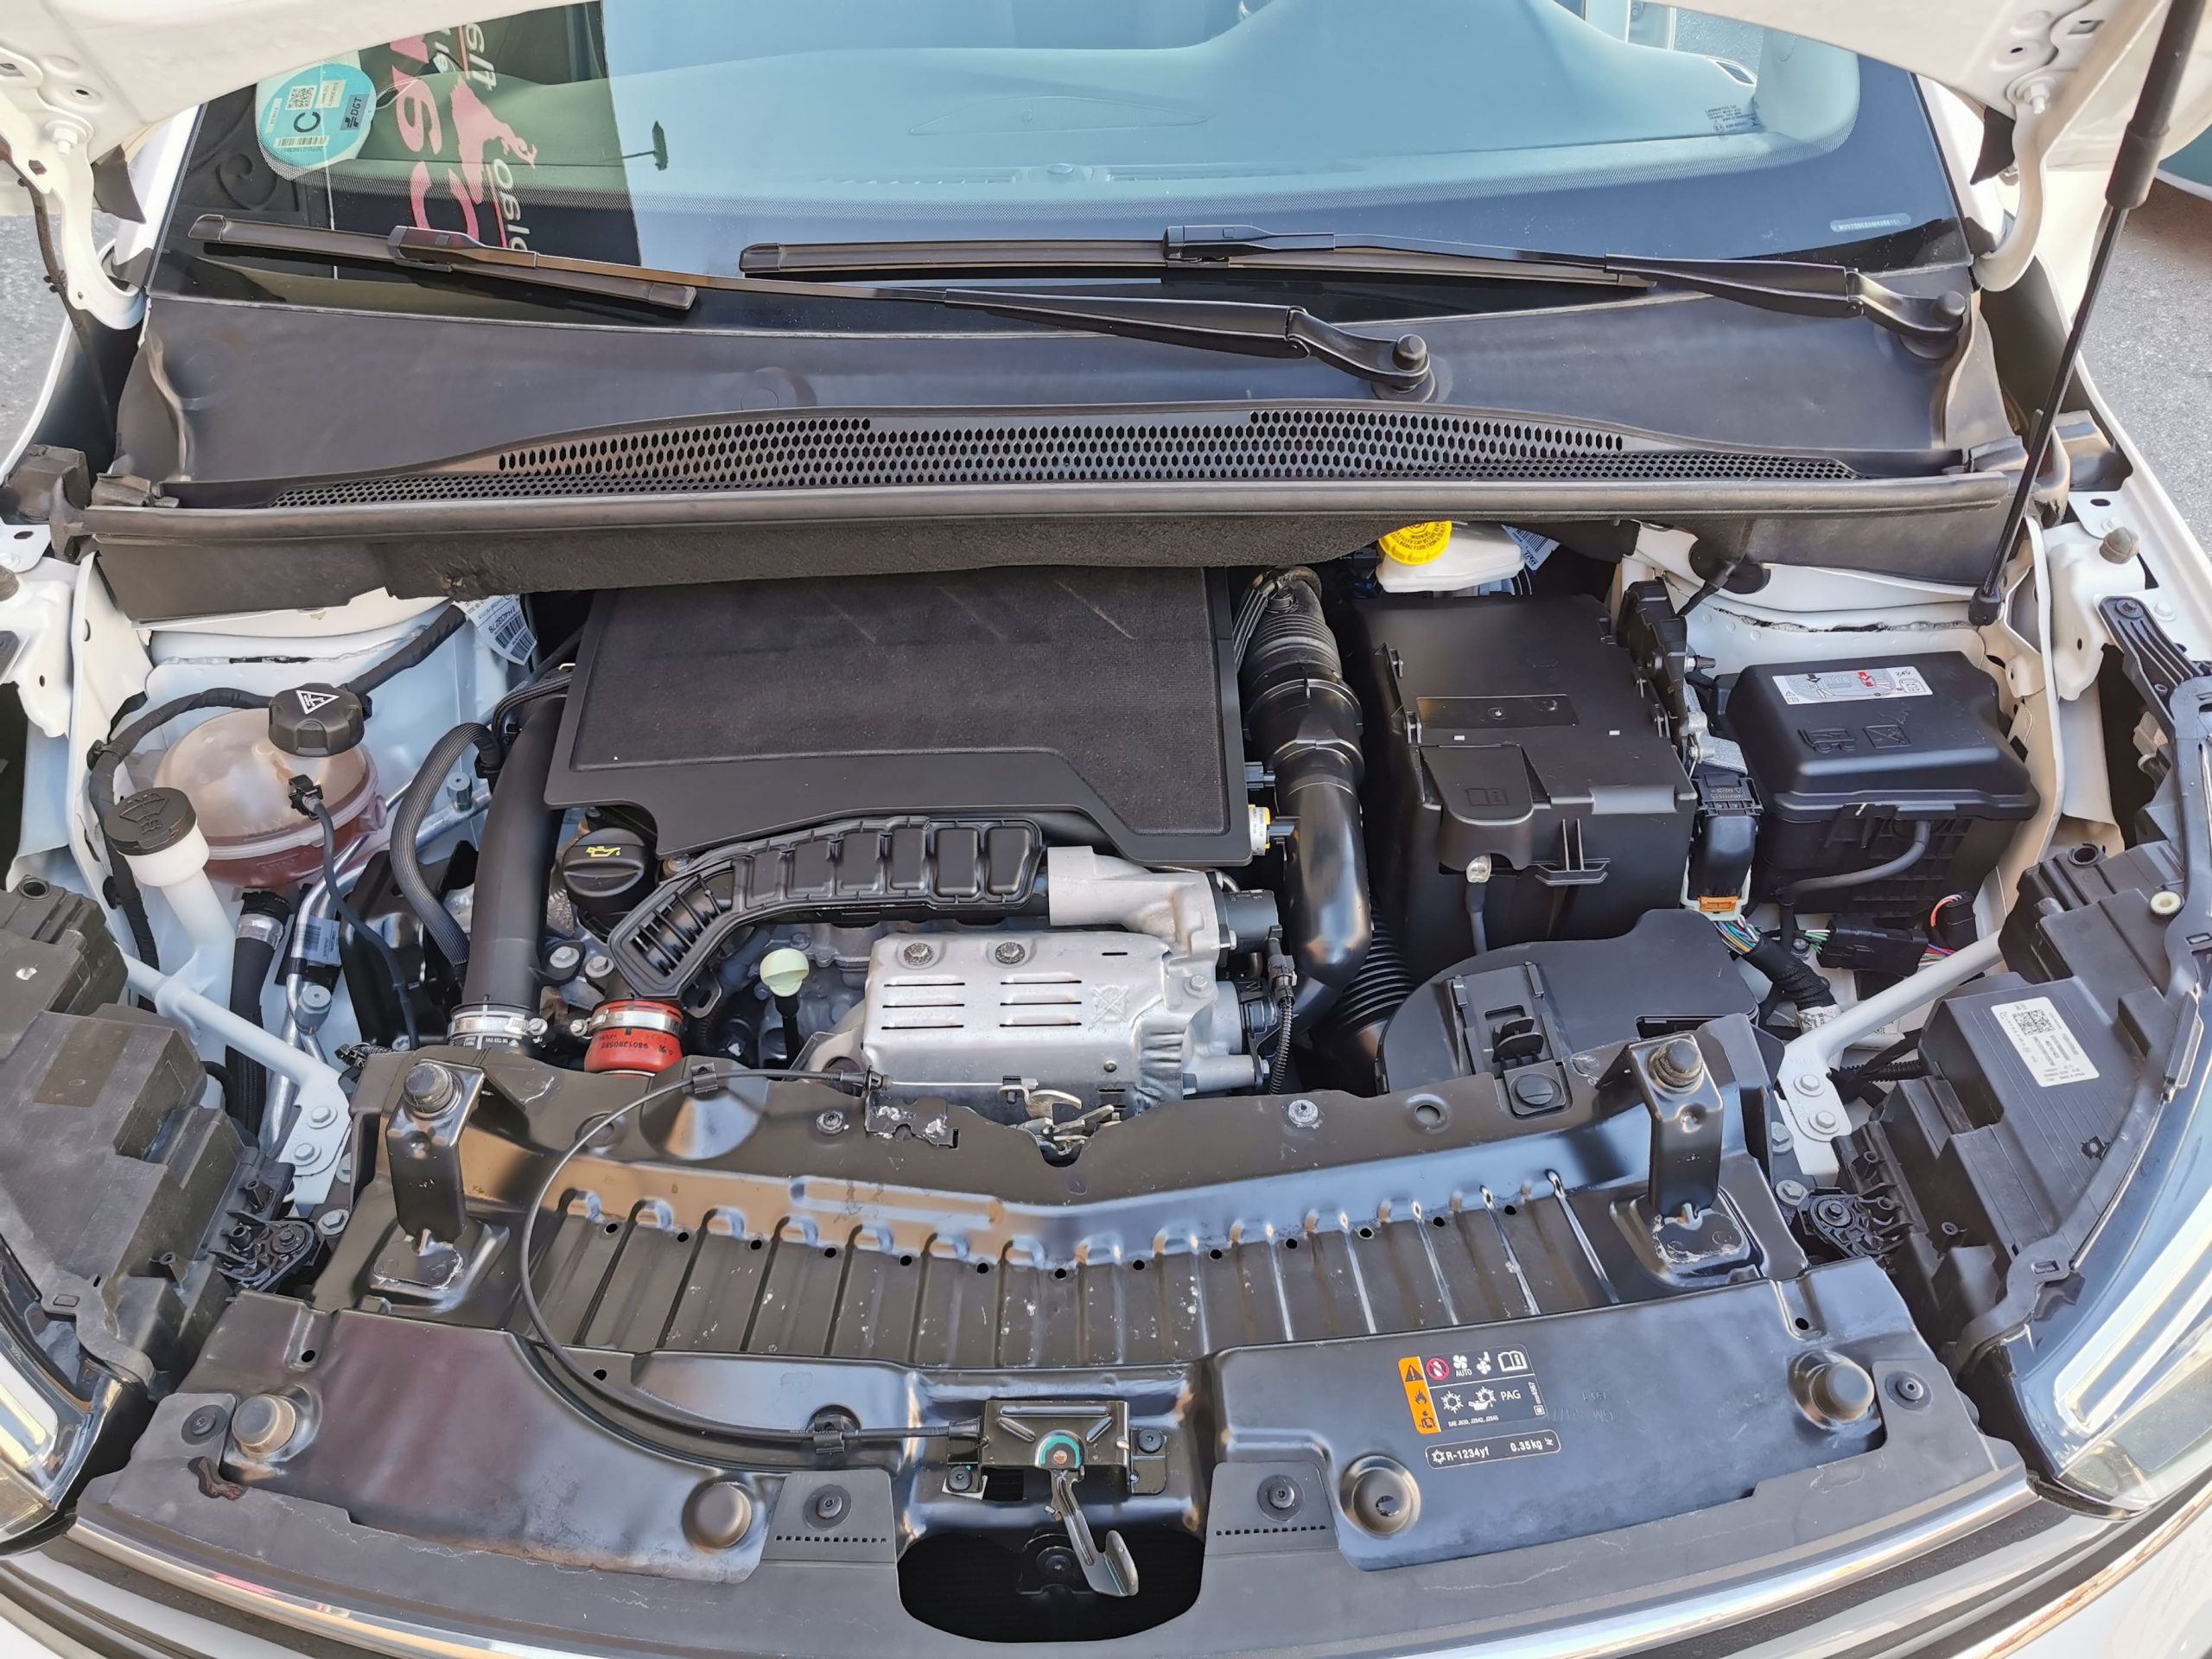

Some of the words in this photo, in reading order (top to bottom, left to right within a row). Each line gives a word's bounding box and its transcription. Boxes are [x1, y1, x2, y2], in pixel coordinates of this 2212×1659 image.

[350, 96, 364, 118] DGT
[293, 111, 321, 133] C
[1455, 1368, 1472, 1377] AUTO
[1500, 1389, 1522, 1402] PAG
[1446, 1446, 1491, 1462] R-1234yf
